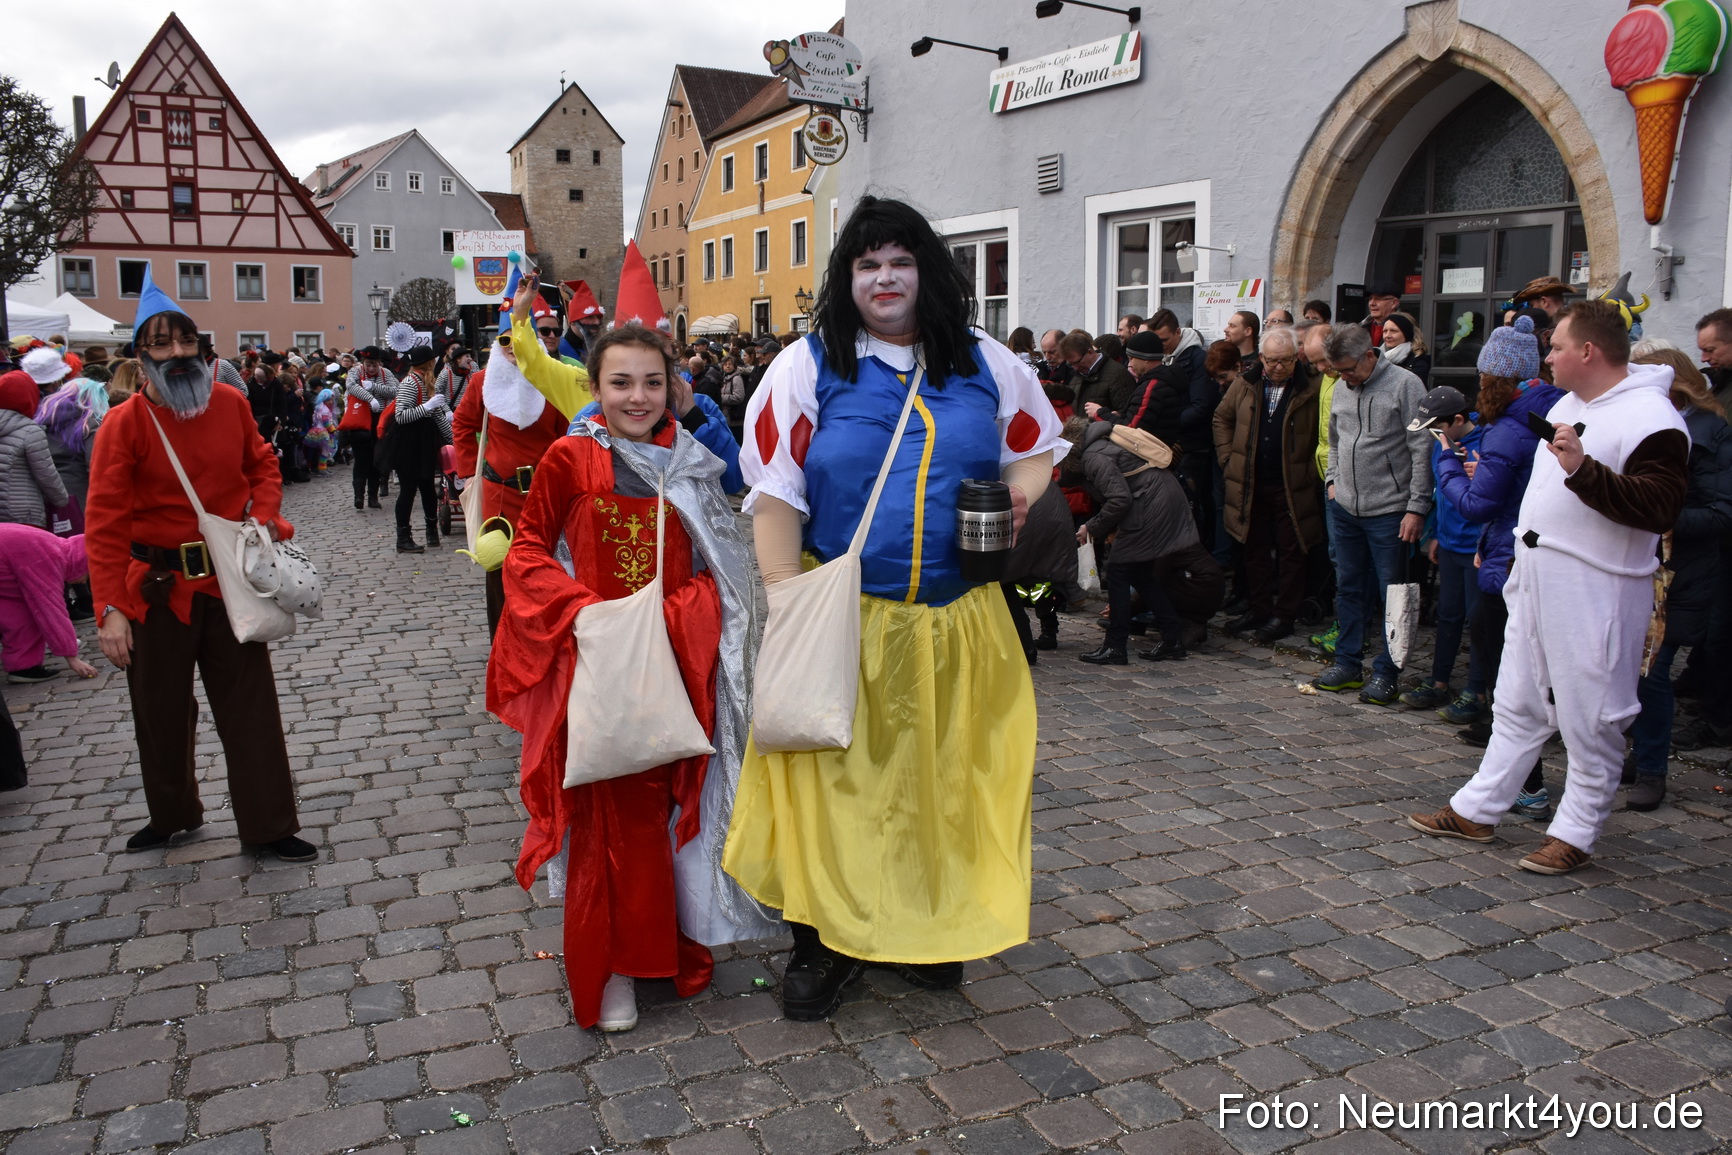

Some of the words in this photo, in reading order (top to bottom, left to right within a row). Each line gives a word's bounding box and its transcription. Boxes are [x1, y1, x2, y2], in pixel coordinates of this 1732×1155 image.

[806, 34, 845, 49] Pizzeria
[816, 50, 836, 61] Café
[1017, 60, 1046, 75] Pizzeria
[1053, 53, 1071, 66] Café
[1079, 44, 1110, 59] Eisdiele
[805, 61, 845, 76] Eisdiele
[1012, 75, 1054, 103] Bella
[1059, 66, 1110, 91] Roma
[792, 89, 823, 99] Roma
[812, 85, 839, 95] Bella
[1198, 290, 1221, 298] Bella
[1206, 297, 1231, 305] Roma
[963, 530, 979, 538] CANA
[980, 531, 1000, 539] PUNTA
